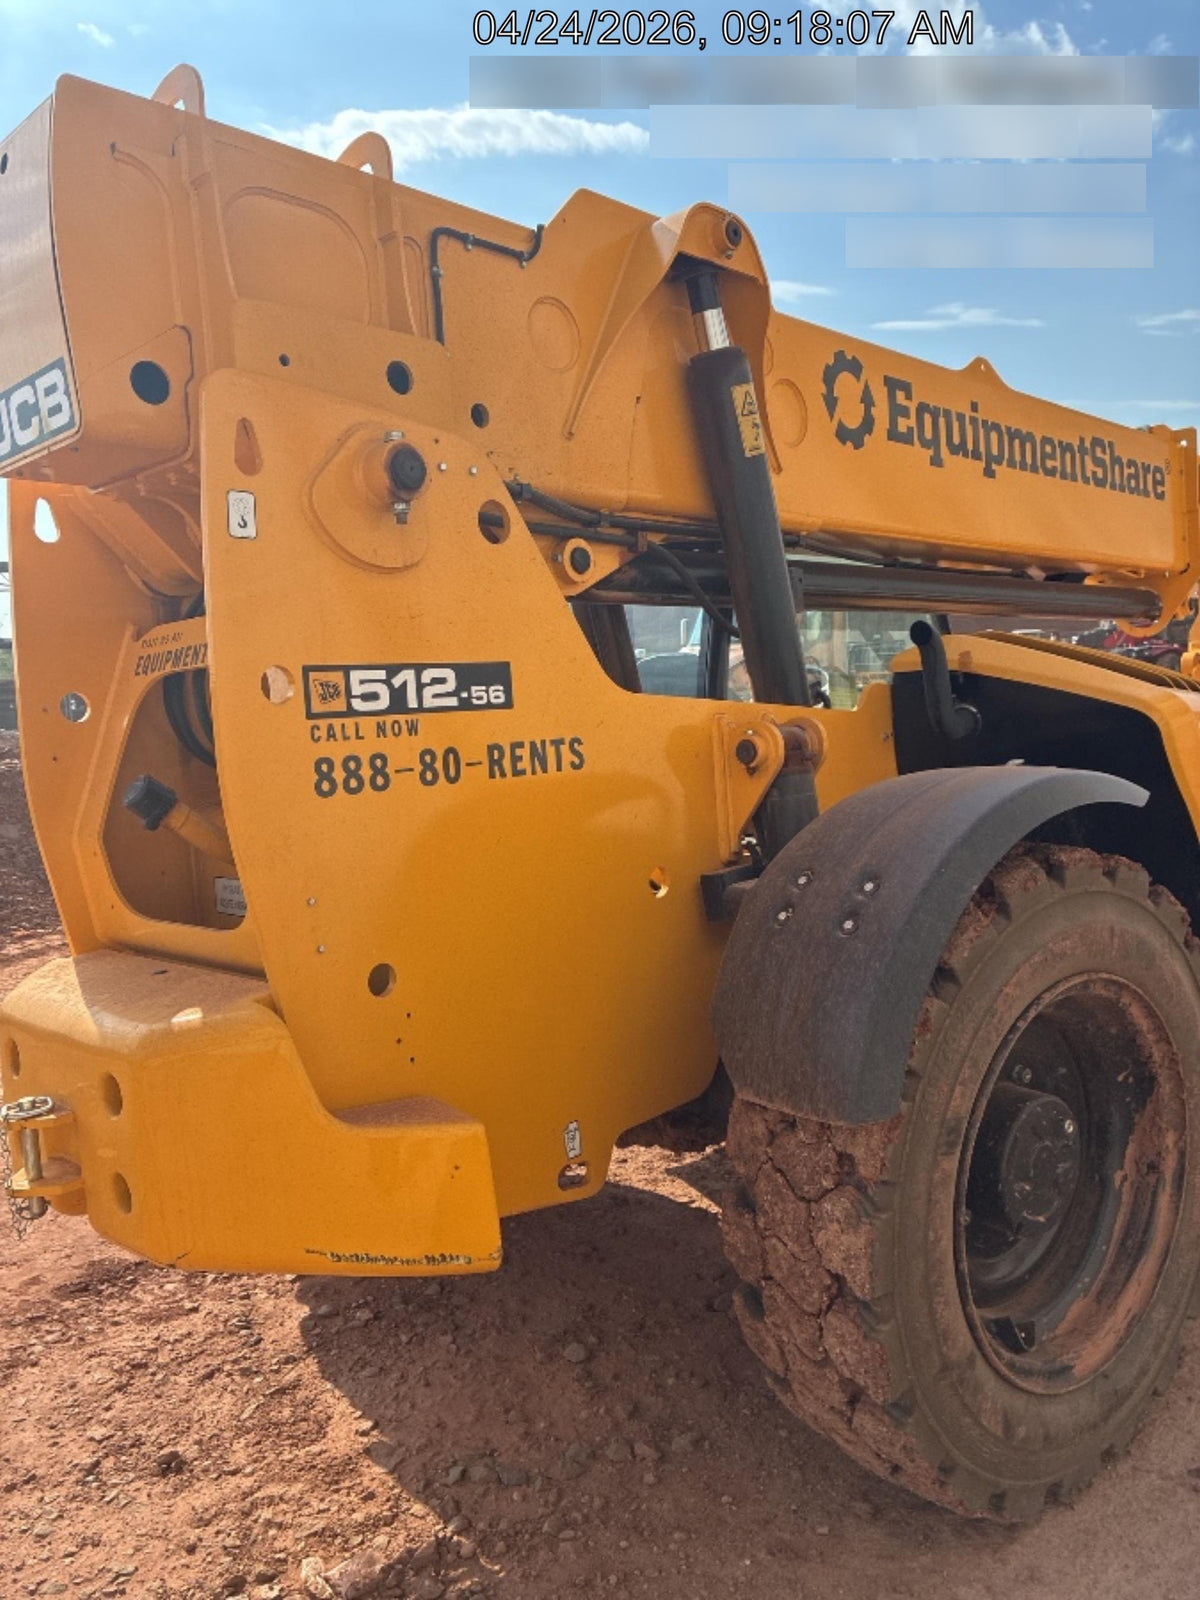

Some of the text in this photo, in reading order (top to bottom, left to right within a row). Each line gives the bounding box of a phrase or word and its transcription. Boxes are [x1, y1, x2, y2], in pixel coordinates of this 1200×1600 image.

[883, 375, 1166, 501] EquipmentShare
[310, 718, 420, 743] CALL NOW
[313, 736, 586, 799] 888-80-RENTS
